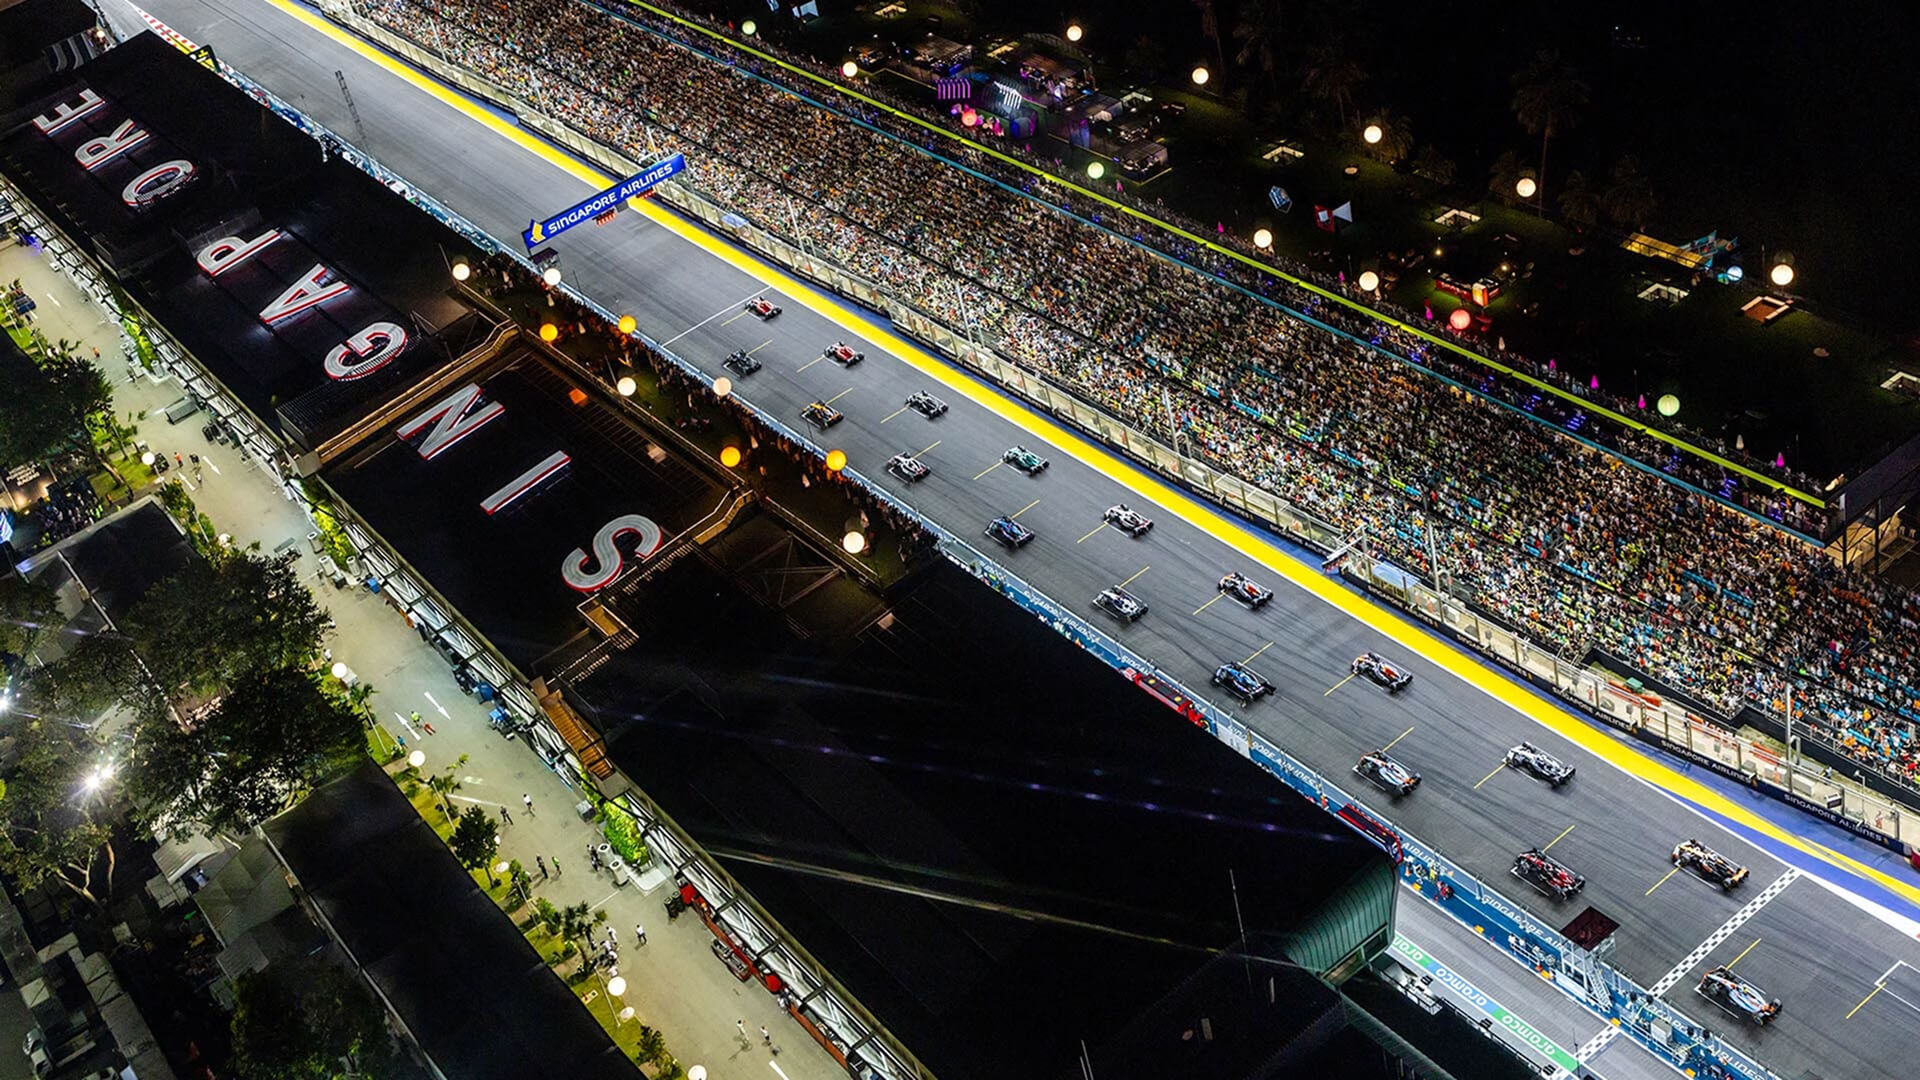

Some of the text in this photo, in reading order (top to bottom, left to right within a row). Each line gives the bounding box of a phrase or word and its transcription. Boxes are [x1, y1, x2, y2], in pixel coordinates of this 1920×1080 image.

[547, 162, 674, 235] SINGAPORE AIRLINES
[32, 86, 663, 593] SINGAPORE
[1661, 739, 1709, 766] SINGAPORE
[1783, 793, 1837, 821] SINGAPORE
[1435, 967, 1488, 1007] aramco
[1501, 1014, 1556, 1055] aramco
